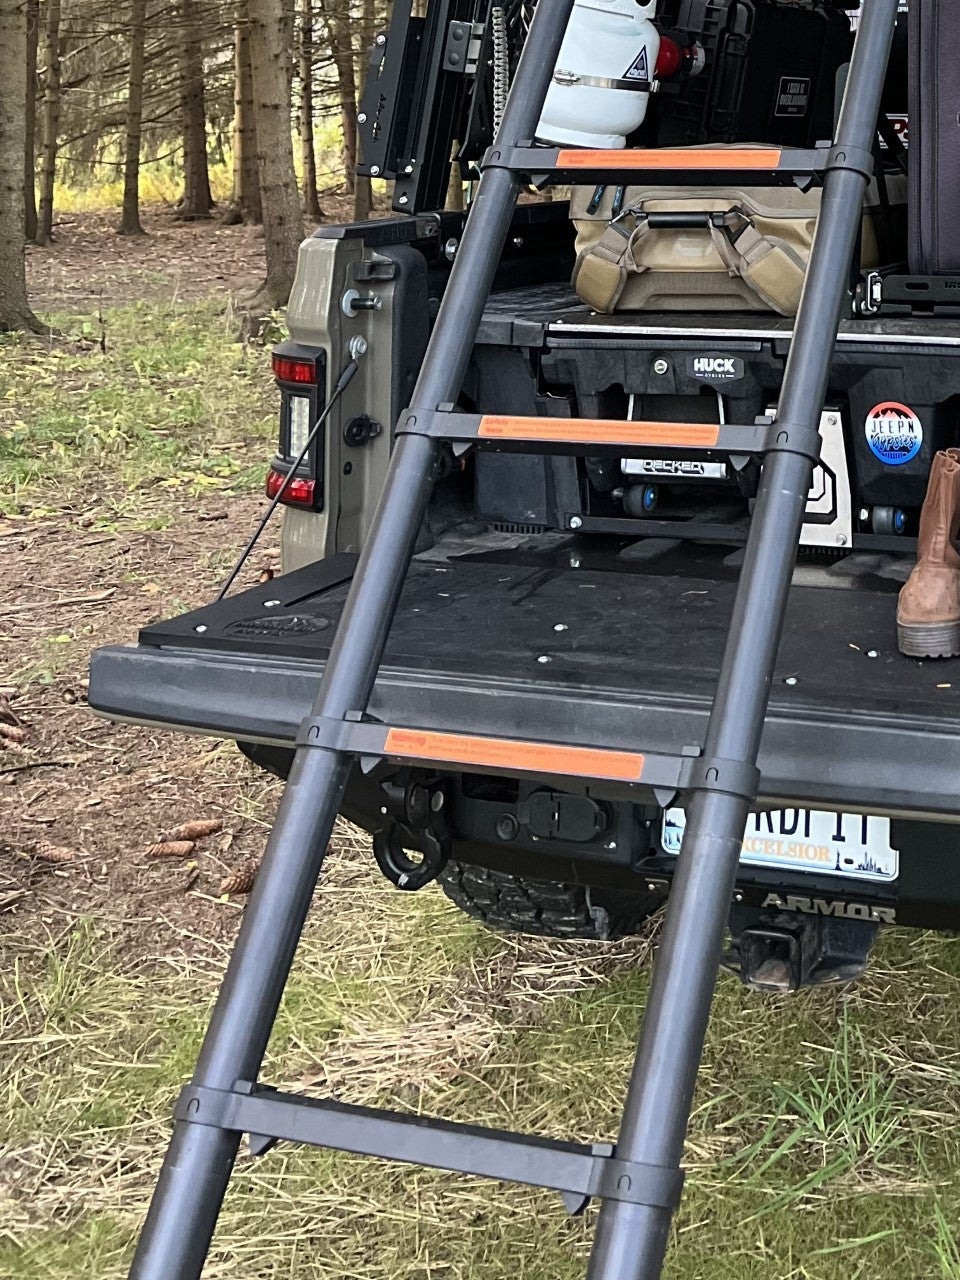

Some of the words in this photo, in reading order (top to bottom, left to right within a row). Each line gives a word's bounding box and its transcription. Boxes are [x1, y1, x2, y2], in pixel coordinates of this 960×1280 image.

[693, 358, 736, 373] HUCK
[871, 420, 915, 434] JEEPN
[643, 459, 704, 474] DECKED
[761, 892, 897, 924] ARMOR
